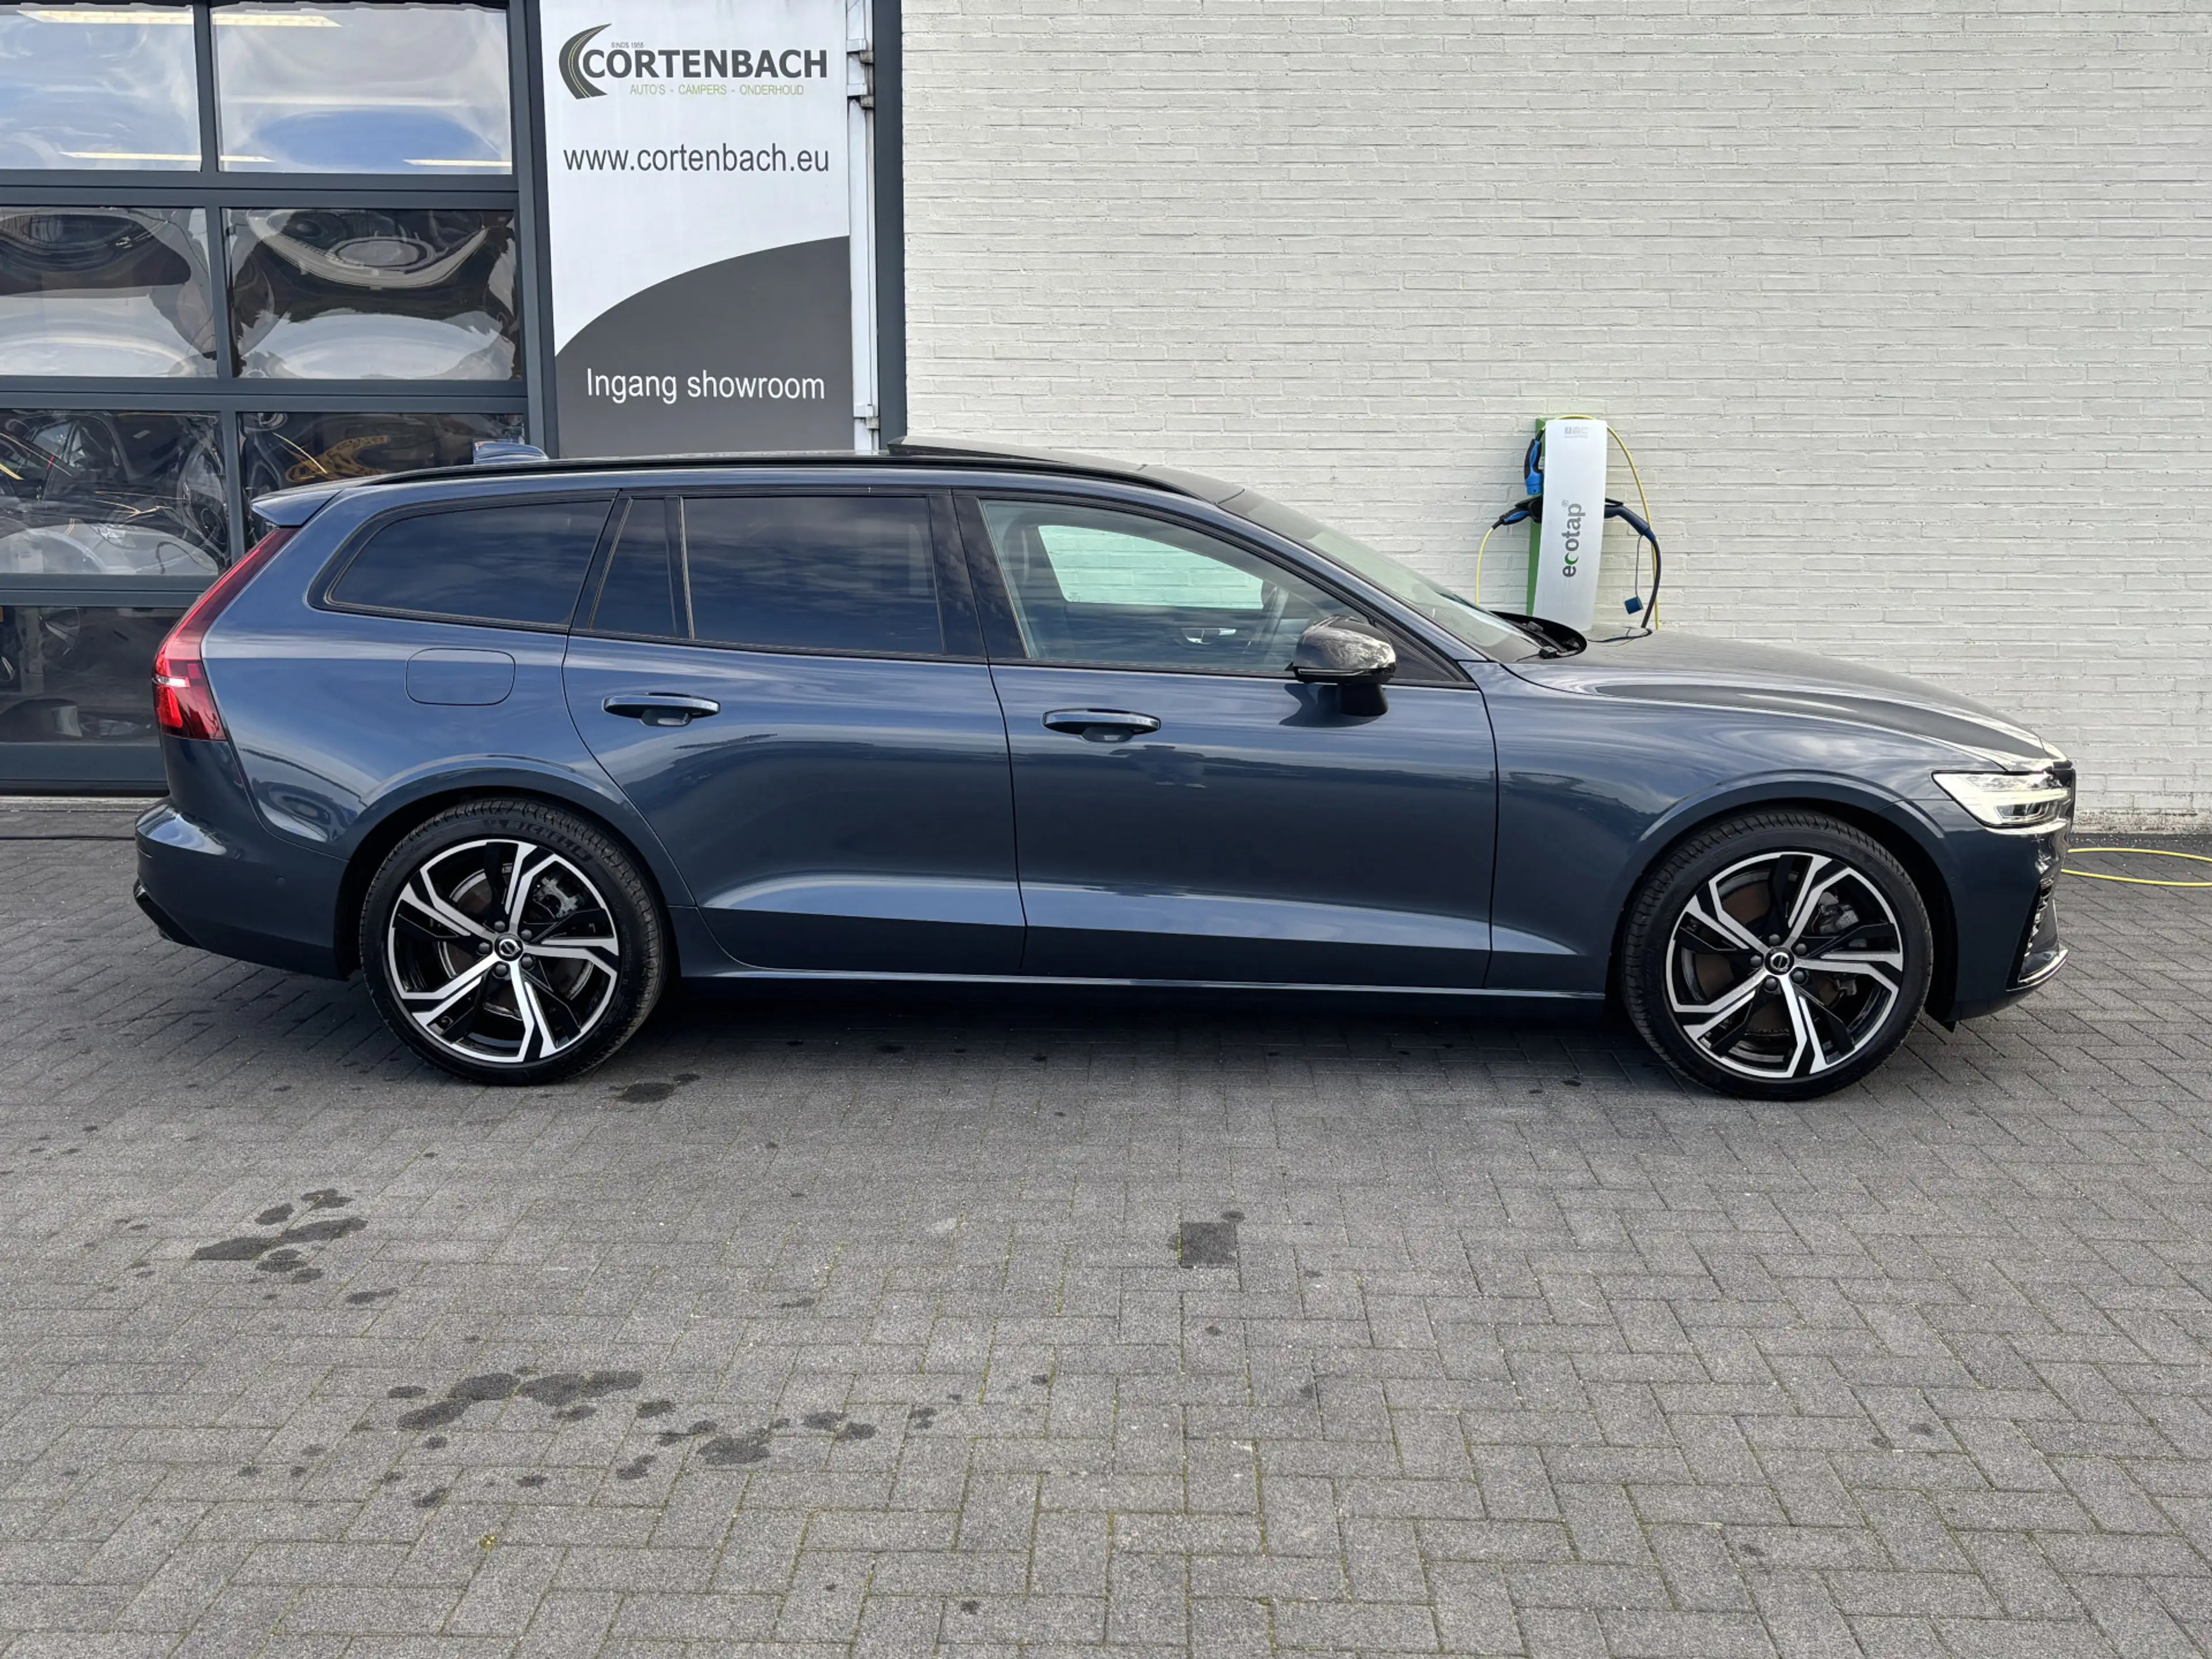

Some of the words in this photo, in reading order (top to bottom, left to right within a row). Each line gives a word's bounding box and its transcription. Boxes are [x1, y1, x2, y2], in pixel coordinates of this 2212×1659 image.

[583, 49, 827, 79] CORTENBACH
[630, 84, 665, 95] AUTO'S
[678, 84, 727, 95] CAMPERS
[740, 84, 804, 96] ONDERHOUD
[563, 143, 829, 172] www.cortenbach.eu
[587, 368, 677, 404] Ingang
[687, 370, 825, 400] showroom
[1562, 503, 1586, 578] ecotap
